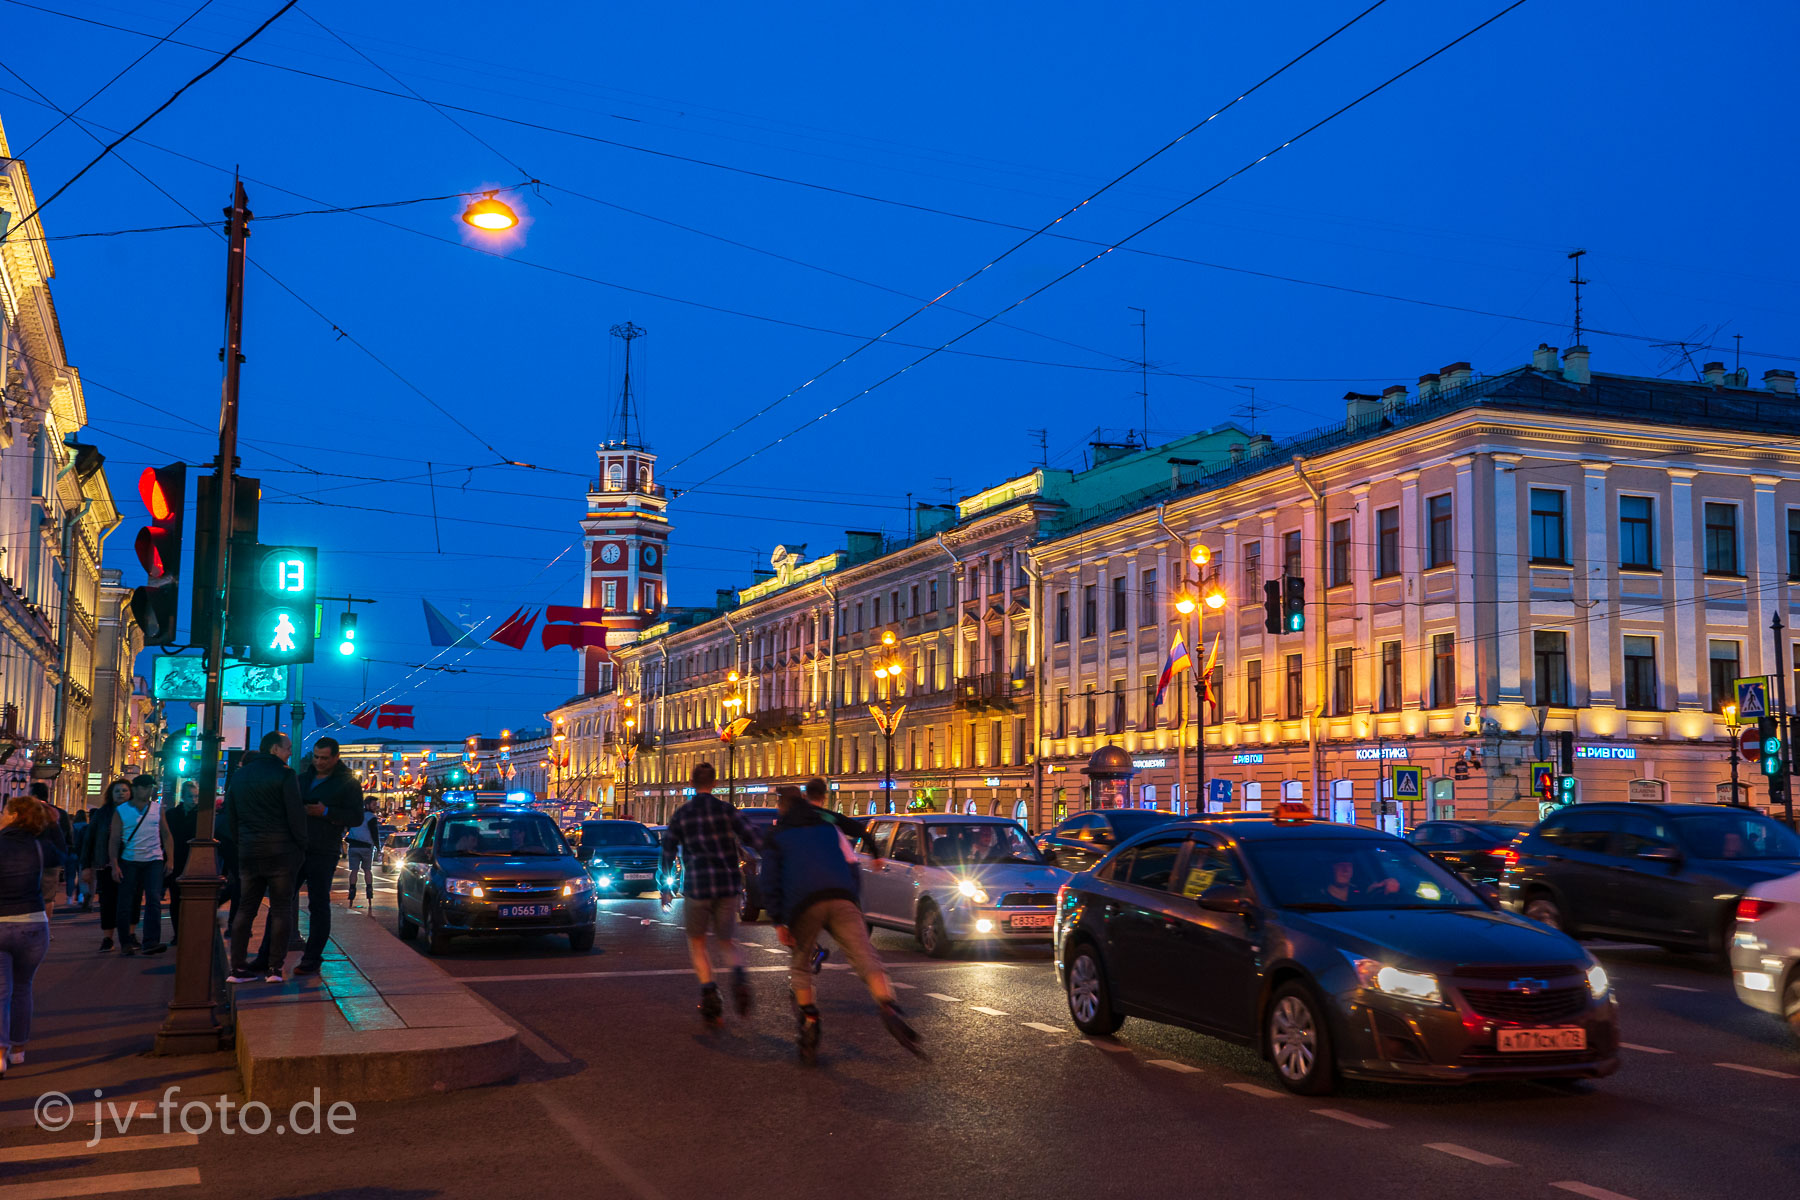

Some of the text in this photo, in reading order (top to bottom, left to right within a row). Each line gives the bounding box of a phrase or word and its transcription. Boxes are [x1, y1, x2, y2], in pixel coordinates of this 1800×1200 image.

[279, 560, 304, 591] 13
[181, 740, 190, 751] 2
[1587, 747, 1636, 759] РИВ ГОШ
[511, 906, 536, 916] 0565
[540, 905, 549, 913] 78
